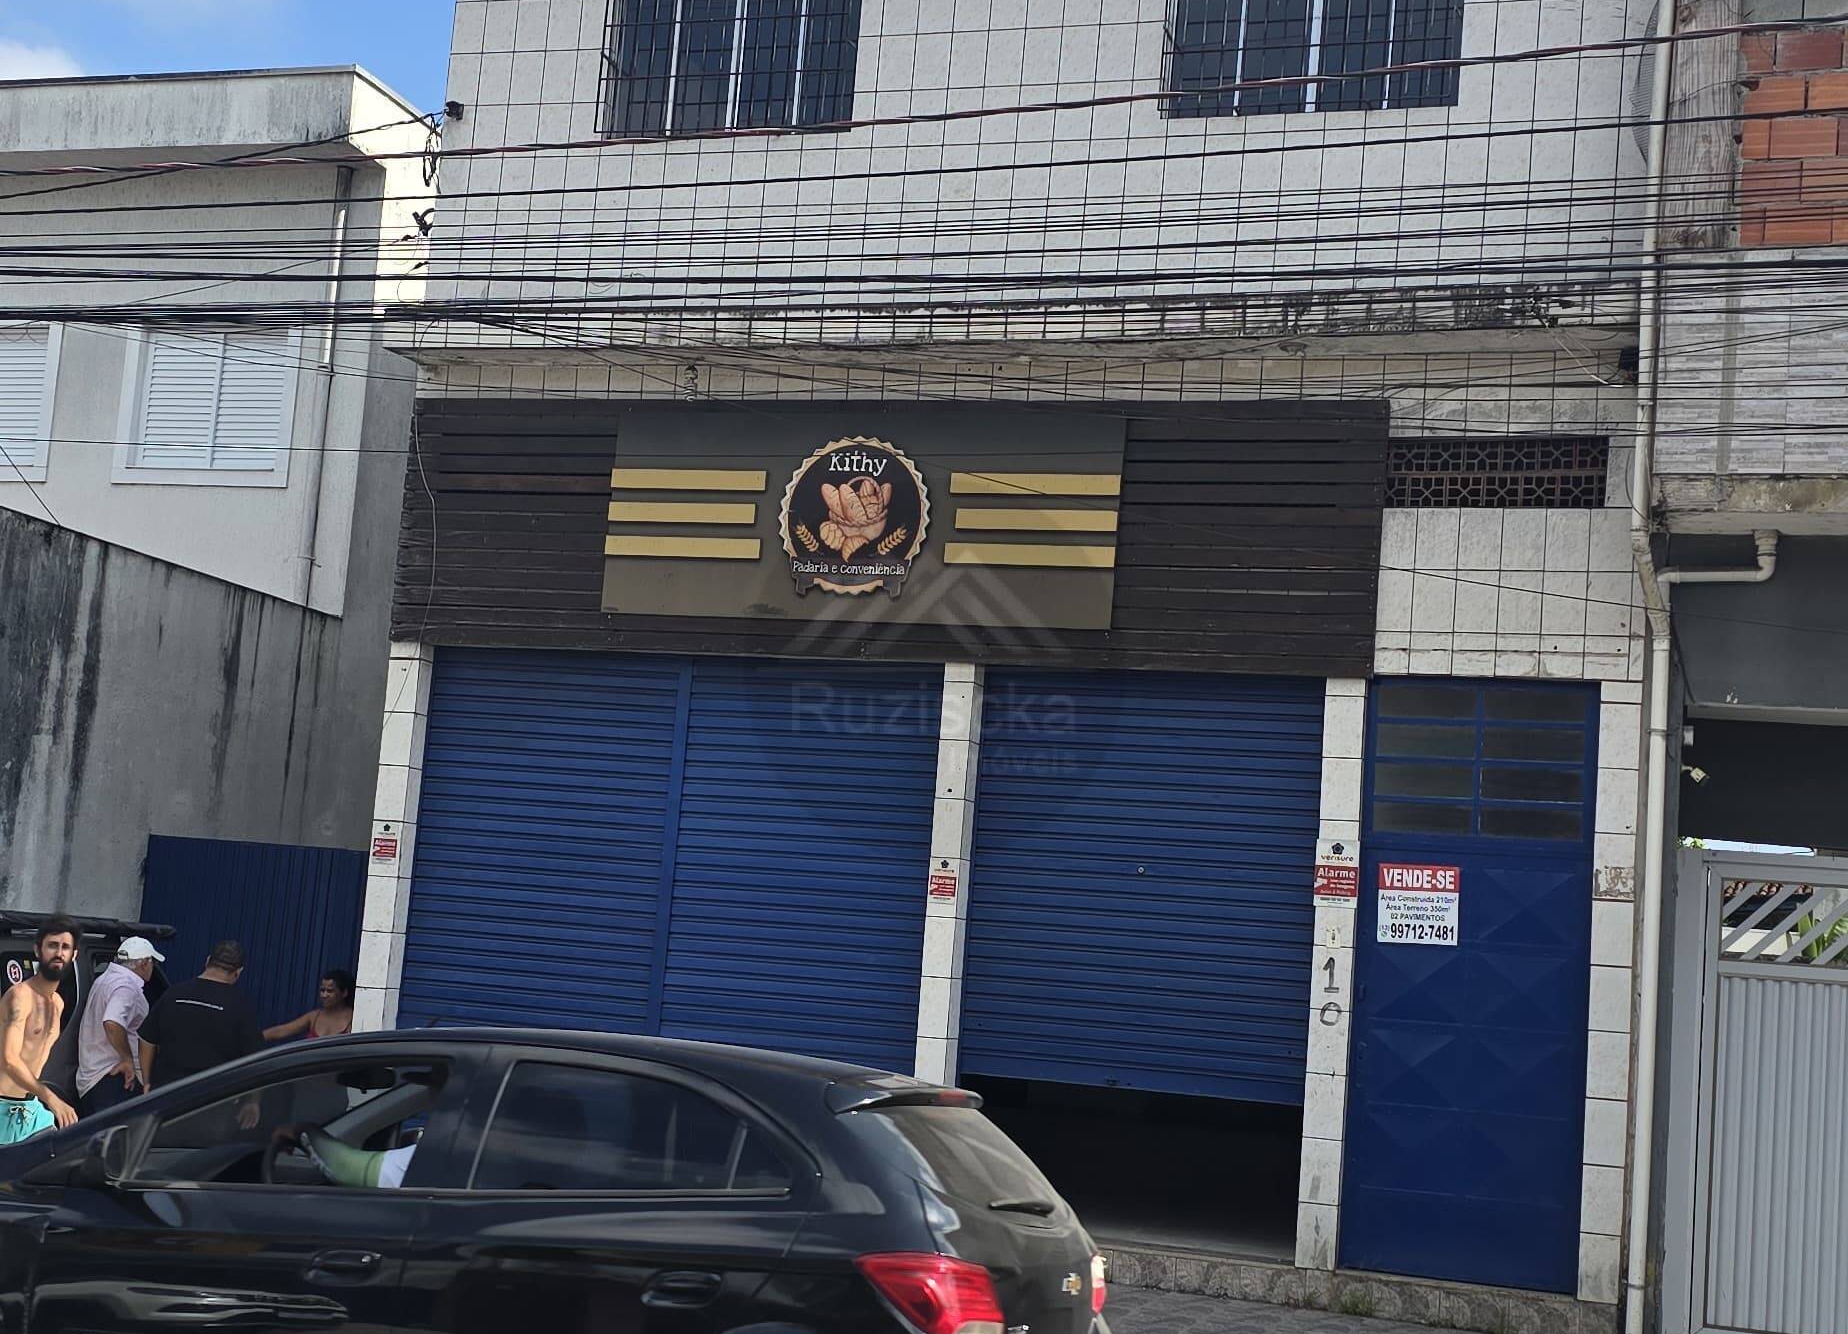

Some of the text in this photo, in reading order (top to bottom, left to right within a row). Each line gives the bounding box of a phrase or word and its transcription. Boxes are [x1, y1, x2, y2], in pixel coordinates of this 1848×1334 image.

[829, 451, 888, 477] Kithy
[793, 561, 829, 572] Padaria
[831, 564, 838, 573] e
[1317, 867, 1356, 879] Alarme
[1383, 868, 1455, 890] VENDE-SE
[1400, 913, 1446, 922] PAVIMENTOS
[1391, 923, 1455, 941] 99712-7481
